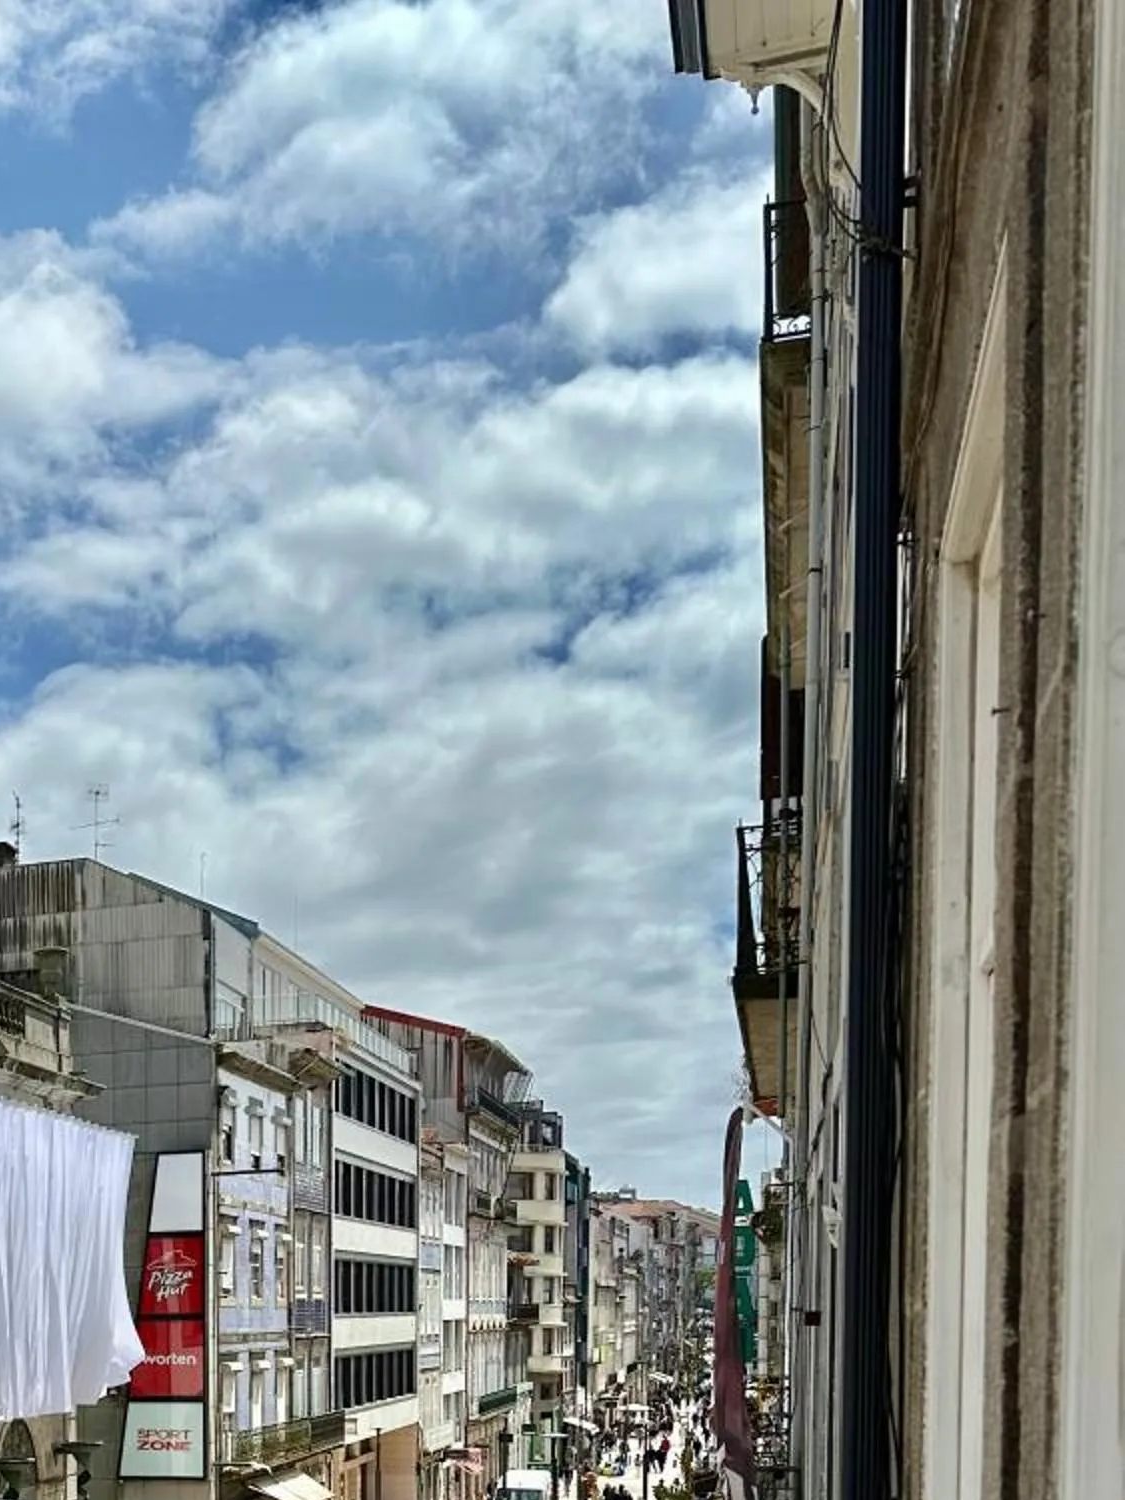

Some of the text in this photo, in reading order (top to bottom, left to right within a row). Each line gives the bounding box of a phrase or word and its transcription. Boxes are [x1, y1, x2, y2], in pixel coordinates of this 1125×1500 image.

[157, 1283, 192, 1303] Hut
[143, 1352, 197, 1366] worten
[137, 1428, 192, 1440] SPORT
[137, 1440, 191, 1450] ZONE
